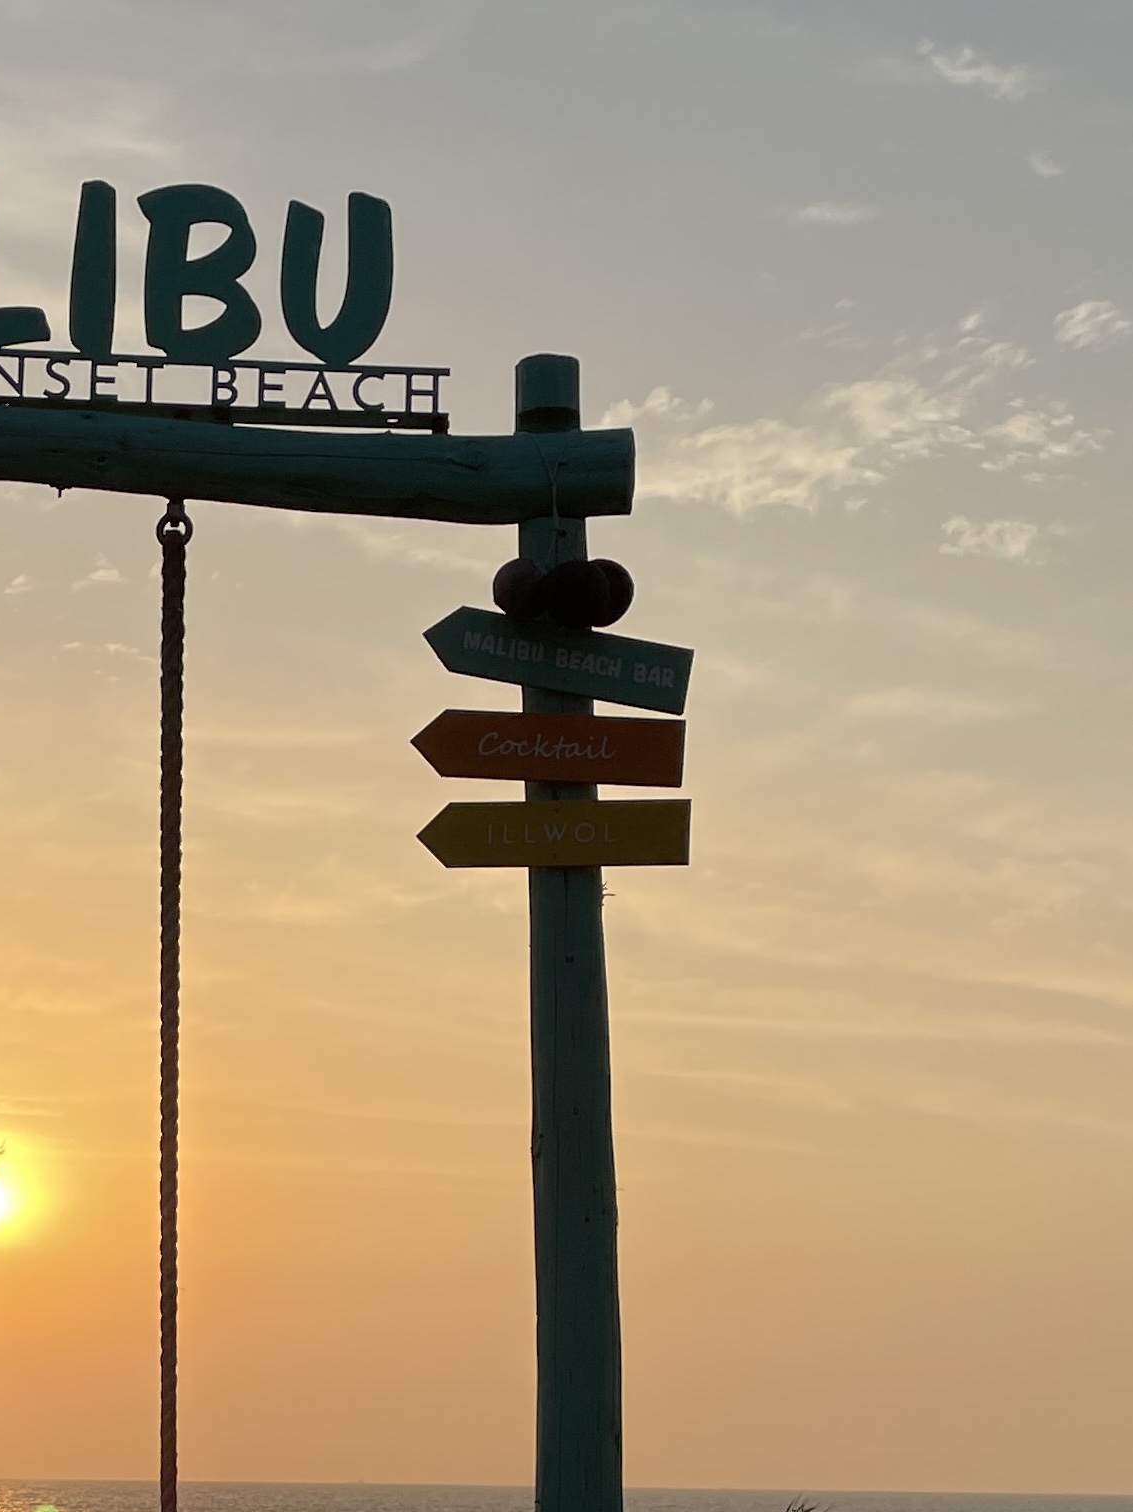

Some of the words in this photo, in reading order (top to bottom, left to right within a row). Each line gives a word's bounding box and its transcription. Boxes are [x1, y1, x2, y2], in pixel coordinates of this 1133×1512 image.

[212, 365, 441, 414] BEACH
[463, 631, 544, 663] MALIBU
[555, 648, 622, 678] BEACH
[633, 663, 676, 688] BAR
[478, 731, 618, 760] Cocktail
[487, 822, 616, 844] ILLWOL
